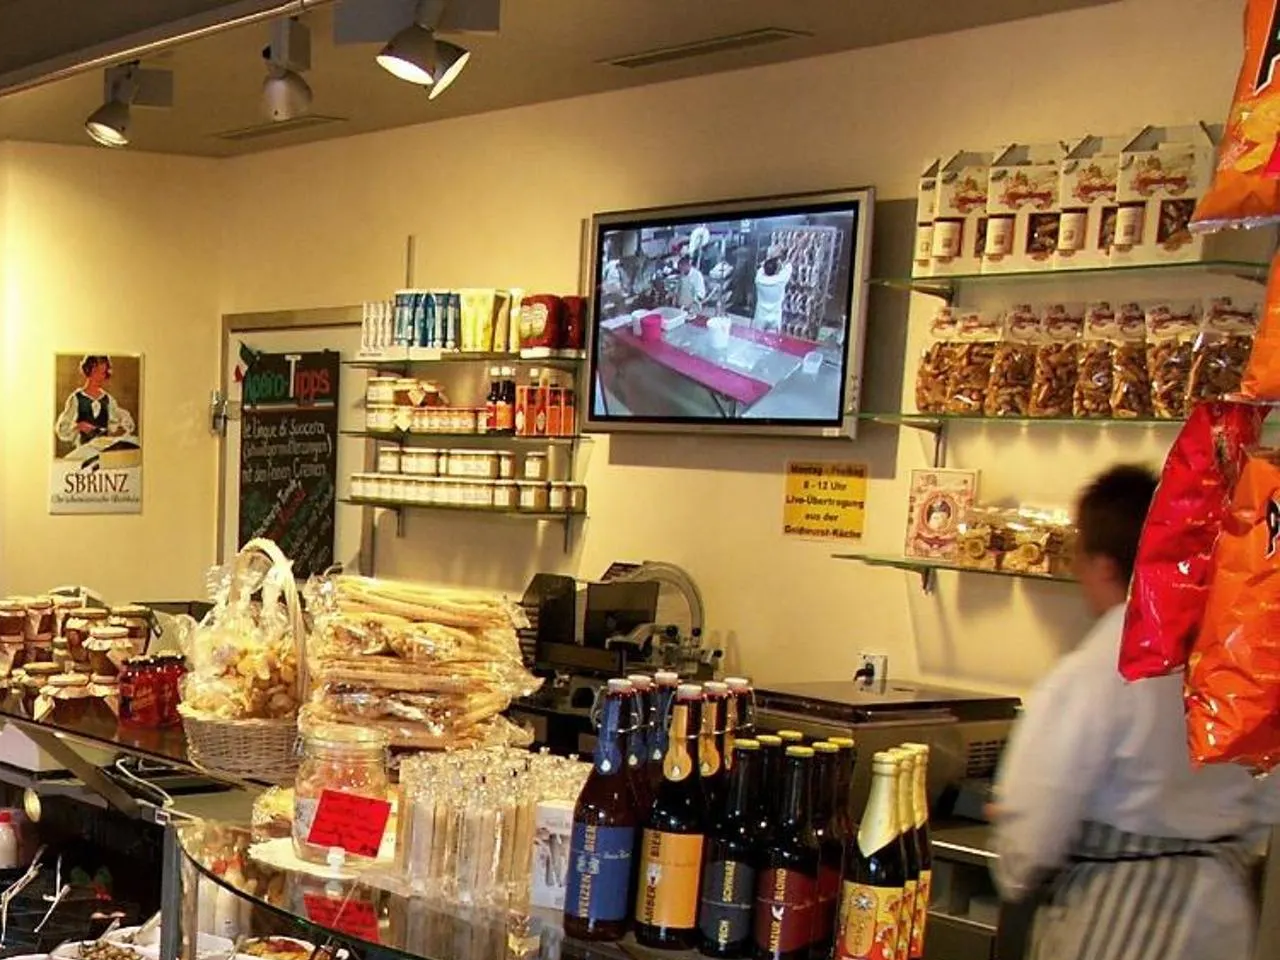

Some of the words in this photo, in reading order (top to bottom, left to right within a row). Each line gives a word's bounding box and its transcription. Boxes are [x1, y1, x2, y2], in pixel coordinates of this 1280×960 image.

[64, 473, 129, 493] SBRINZ
[818, 481, 828, 490] 12
[831, 482, 847, 491] Uhr
[786, 495, 864, 509] Live-Übertragung
[805, 513, 821, 521] aus
[823, 512, 839, 521] der
[583, 824, 598, 852] BIER
[643, 885, 657, 924] AMBER
[650, 831, 662, 857] BIER
[722, 861, 736, 902] SCHWARZ
[774, 868, 788, 902] BLOND
[577, 873, 592, 918] WEIZEN
[768, 919, 782, 953] NATUR
